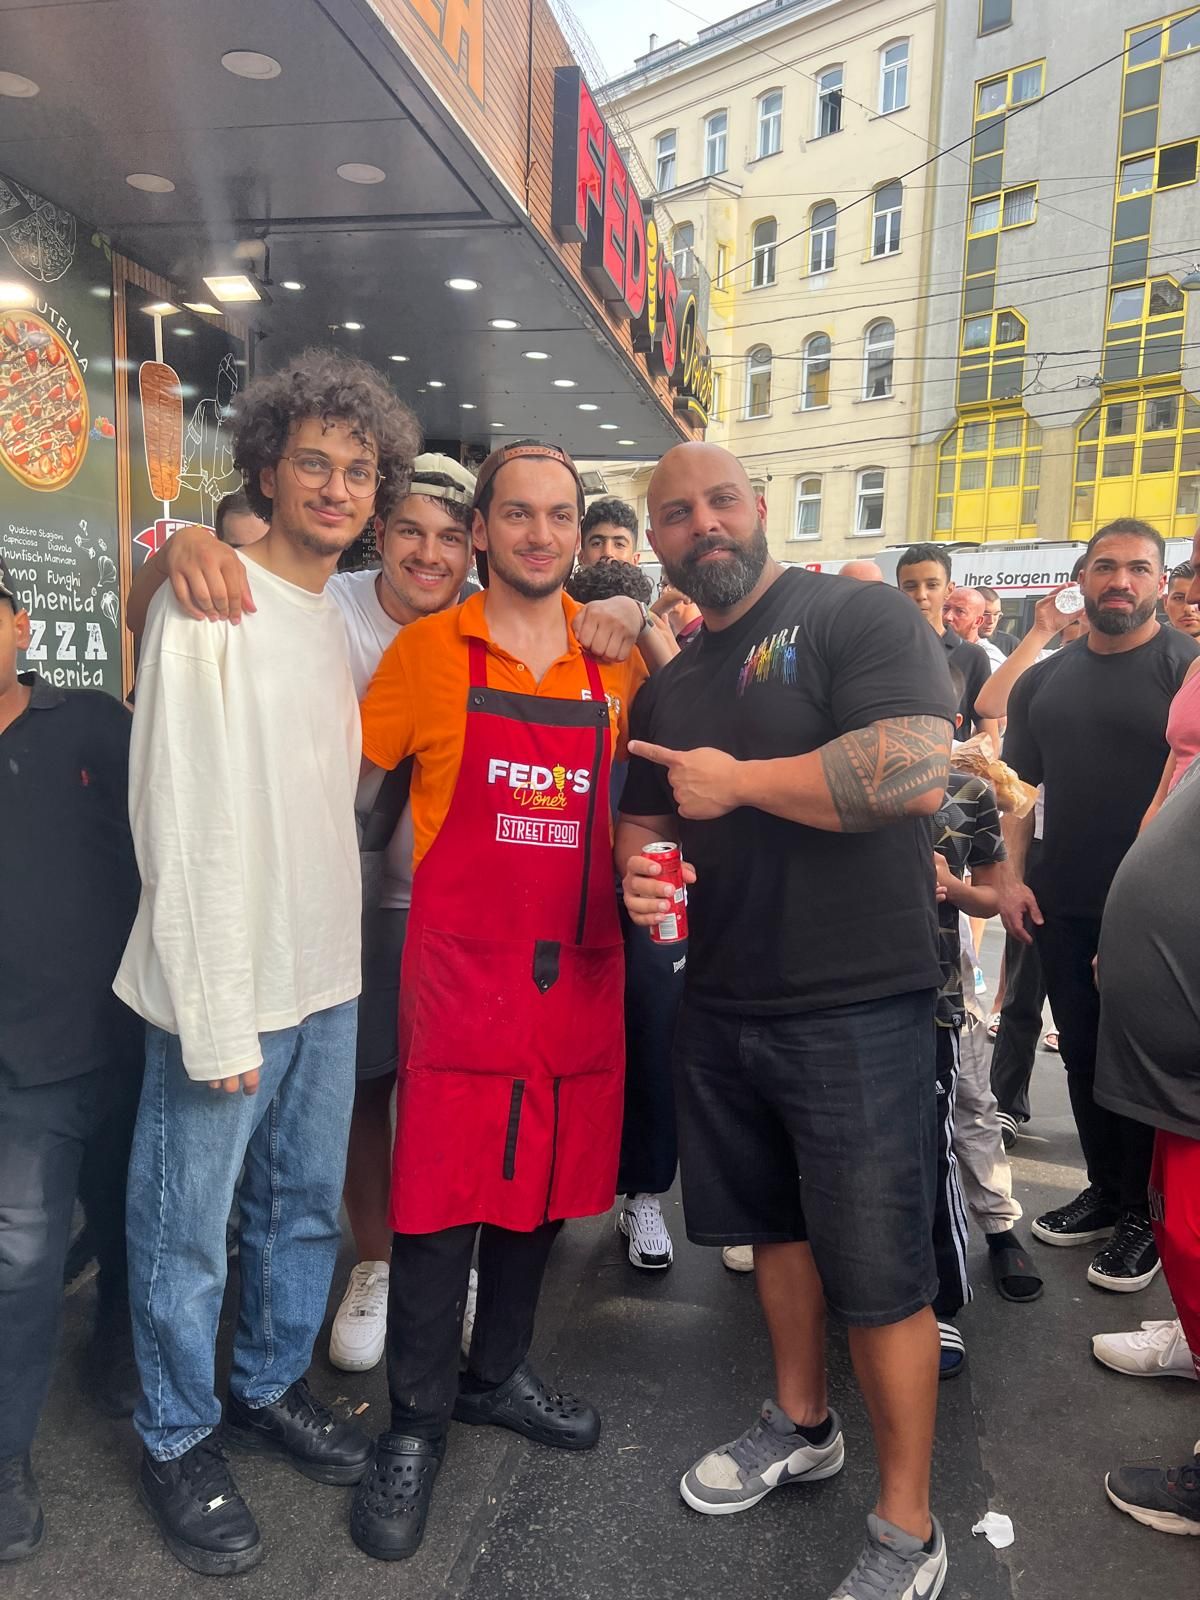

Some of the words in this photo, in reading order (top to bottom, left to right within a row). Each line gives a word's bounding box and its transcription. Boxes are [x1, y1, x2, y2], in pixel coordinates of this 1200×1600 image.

[32, 297, 88, 373] UTELLA
[8, 524, 37, 535] Quattro
[0, 546, 43, 563] Thunfisch
[47, 541, 72, 553] Diavola
[8, 567, 37, 581] nno
[47, 569, 81, 592] Funghi
[964, 573, 993, 586] Ihre
[996, 572, 1051, 587] Sorgen
[17, 584, 94, 617] gherita
[26, 620, 108, 660] ZZA
[16, 661, 104, 687] herita
[502, 819, 546, 842] STREET
[548, 823, 576, 844] FOOD
